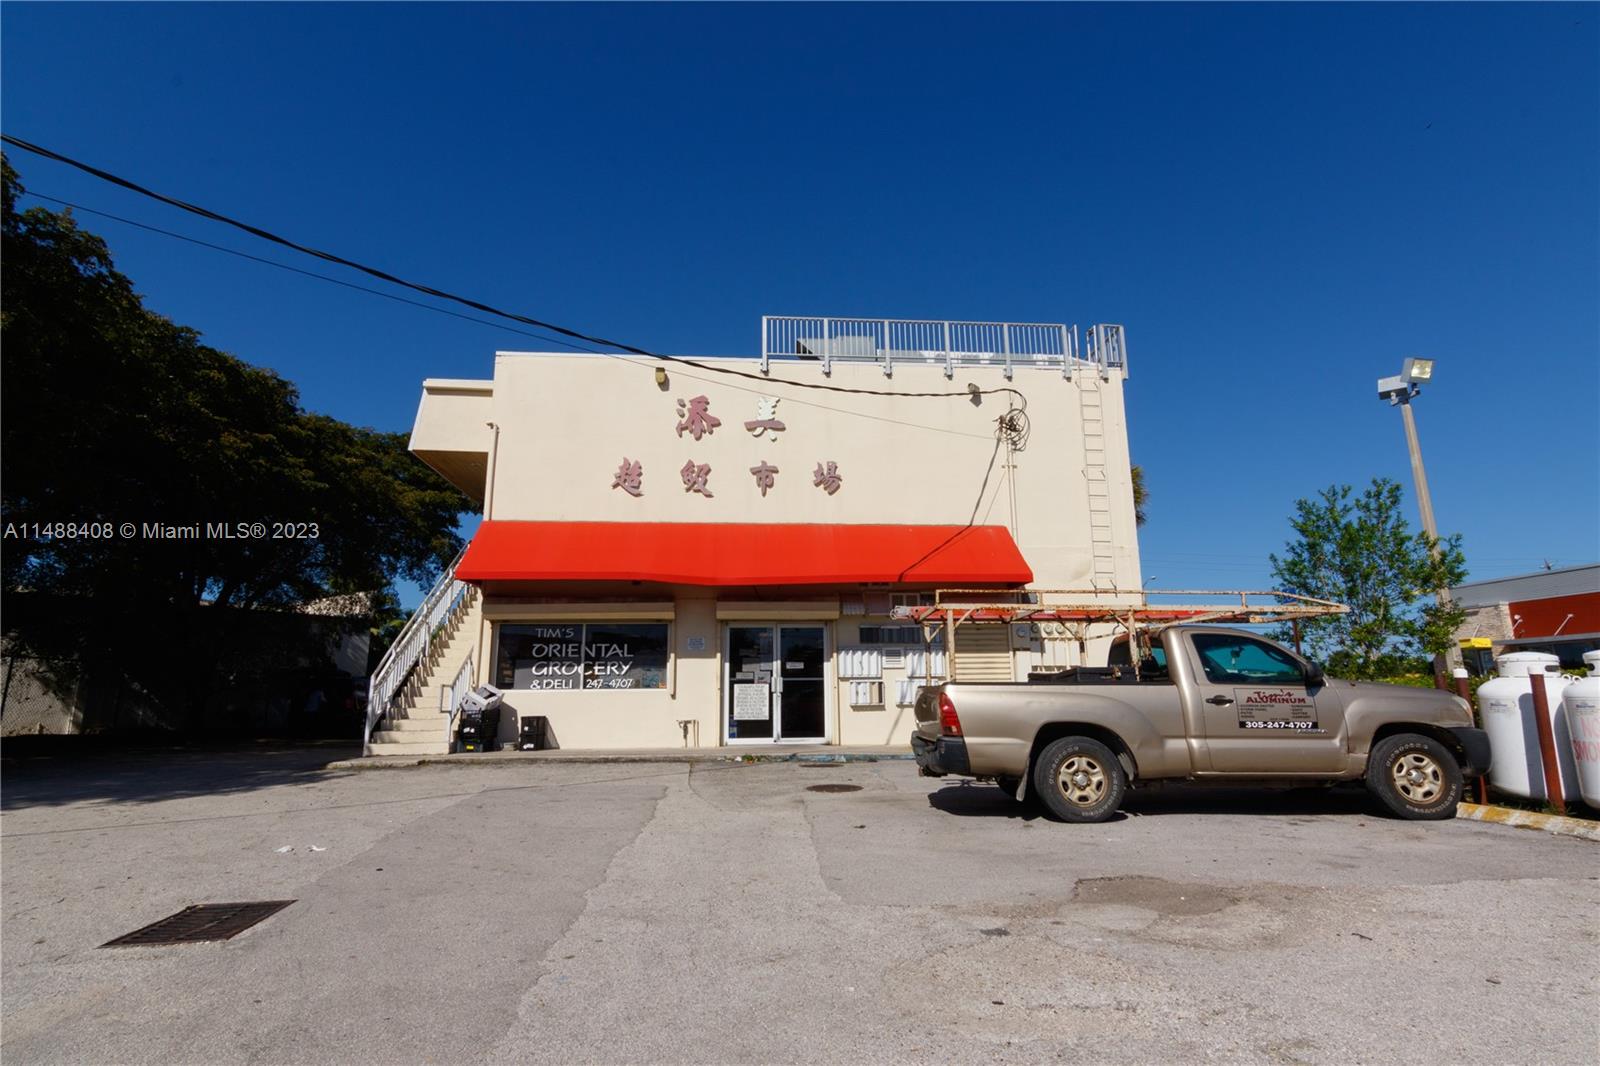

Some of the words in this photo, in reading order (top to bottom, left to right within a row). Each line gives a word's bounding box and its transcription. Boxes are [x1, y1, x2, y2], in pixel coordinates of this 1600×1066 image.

[535, 627, 575, 639] TIM'S
[531, 643, 635, 658] ORIENTAL
[531, 661, 633, 676] GROCERY
[530, 679, 541, 690] &
[542, 679, 573, 689] DELI
[586, 678, 634, 689] 247-4707
[1246, 696, 1306, 704] ALUMINUM
[1245, 721, 1313, 729] 305-247-4707
